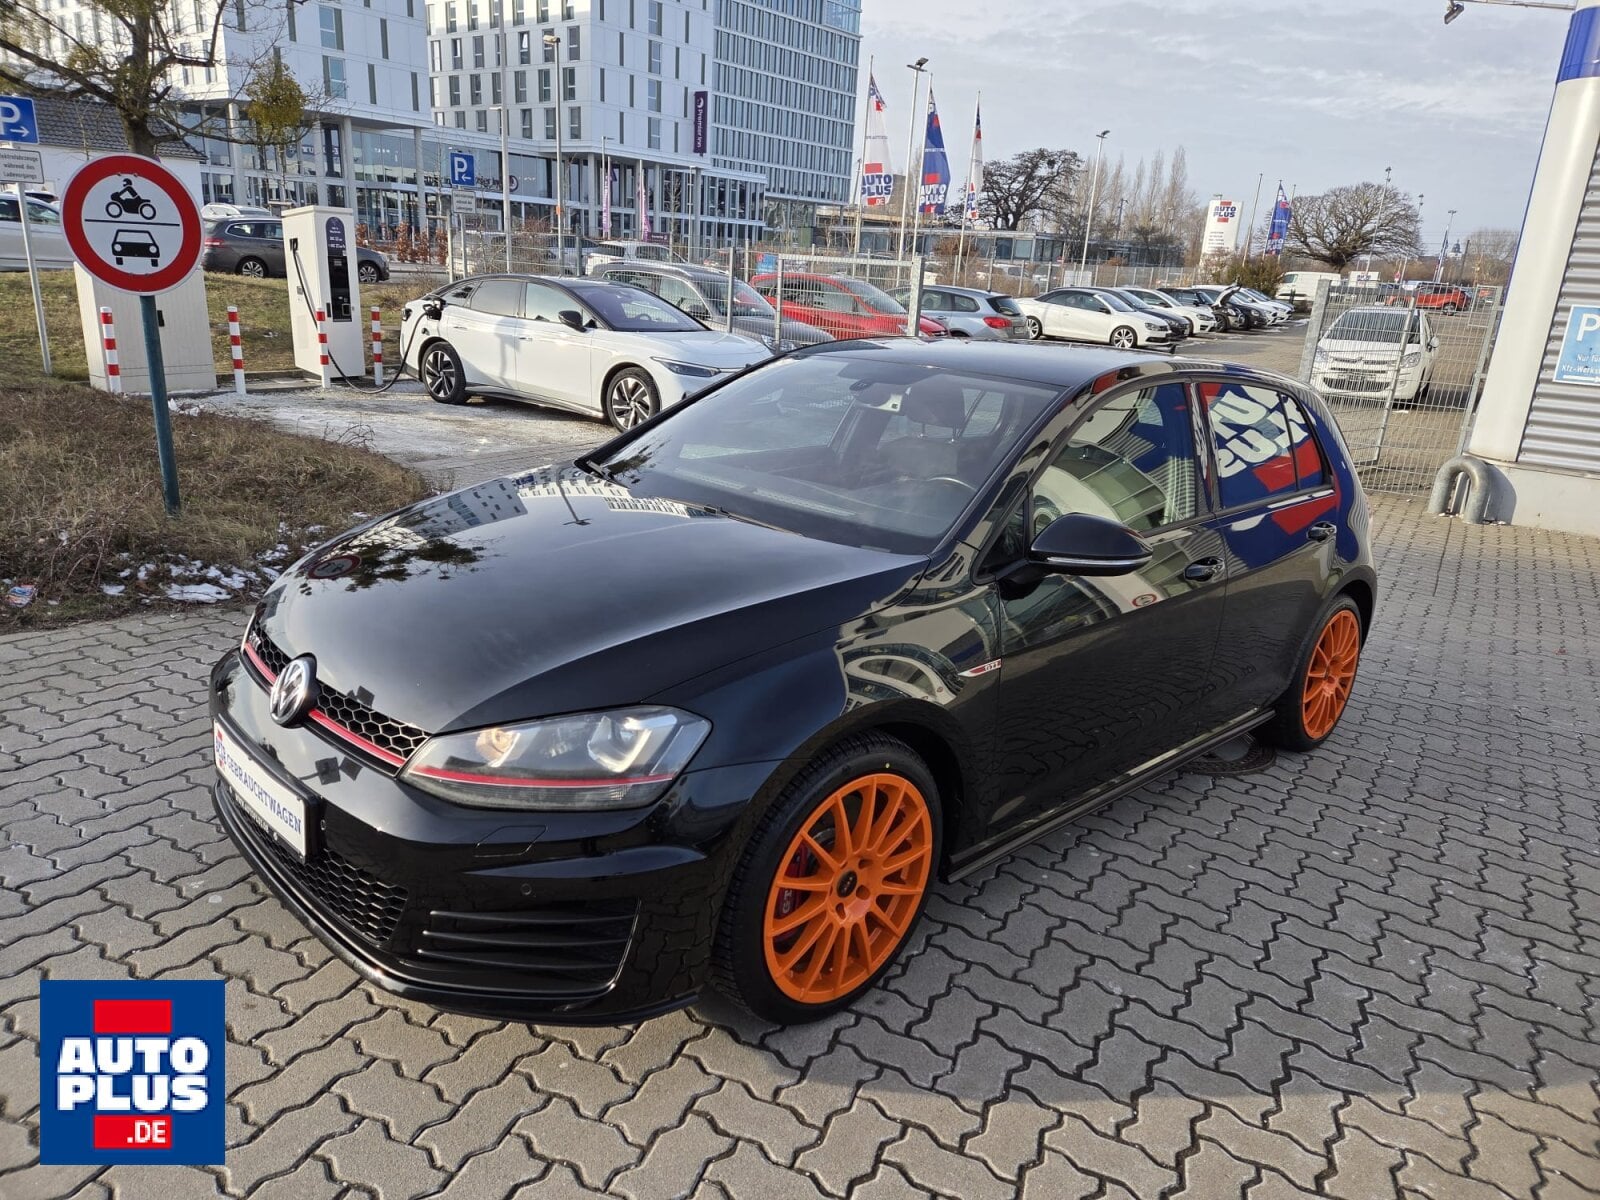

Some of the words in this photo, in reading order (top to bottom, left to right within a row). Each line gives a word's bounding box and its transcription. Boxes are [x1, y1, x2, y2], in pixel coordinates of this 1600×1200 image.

[0, 101, 20, 136] P
[454, 156, 468, 181] P
[920, 194, 945, 206] PLUS
[1576, 313, 1600, 341] P
[226, 754, 302, 835] GEBRAUCHTWAGEN
